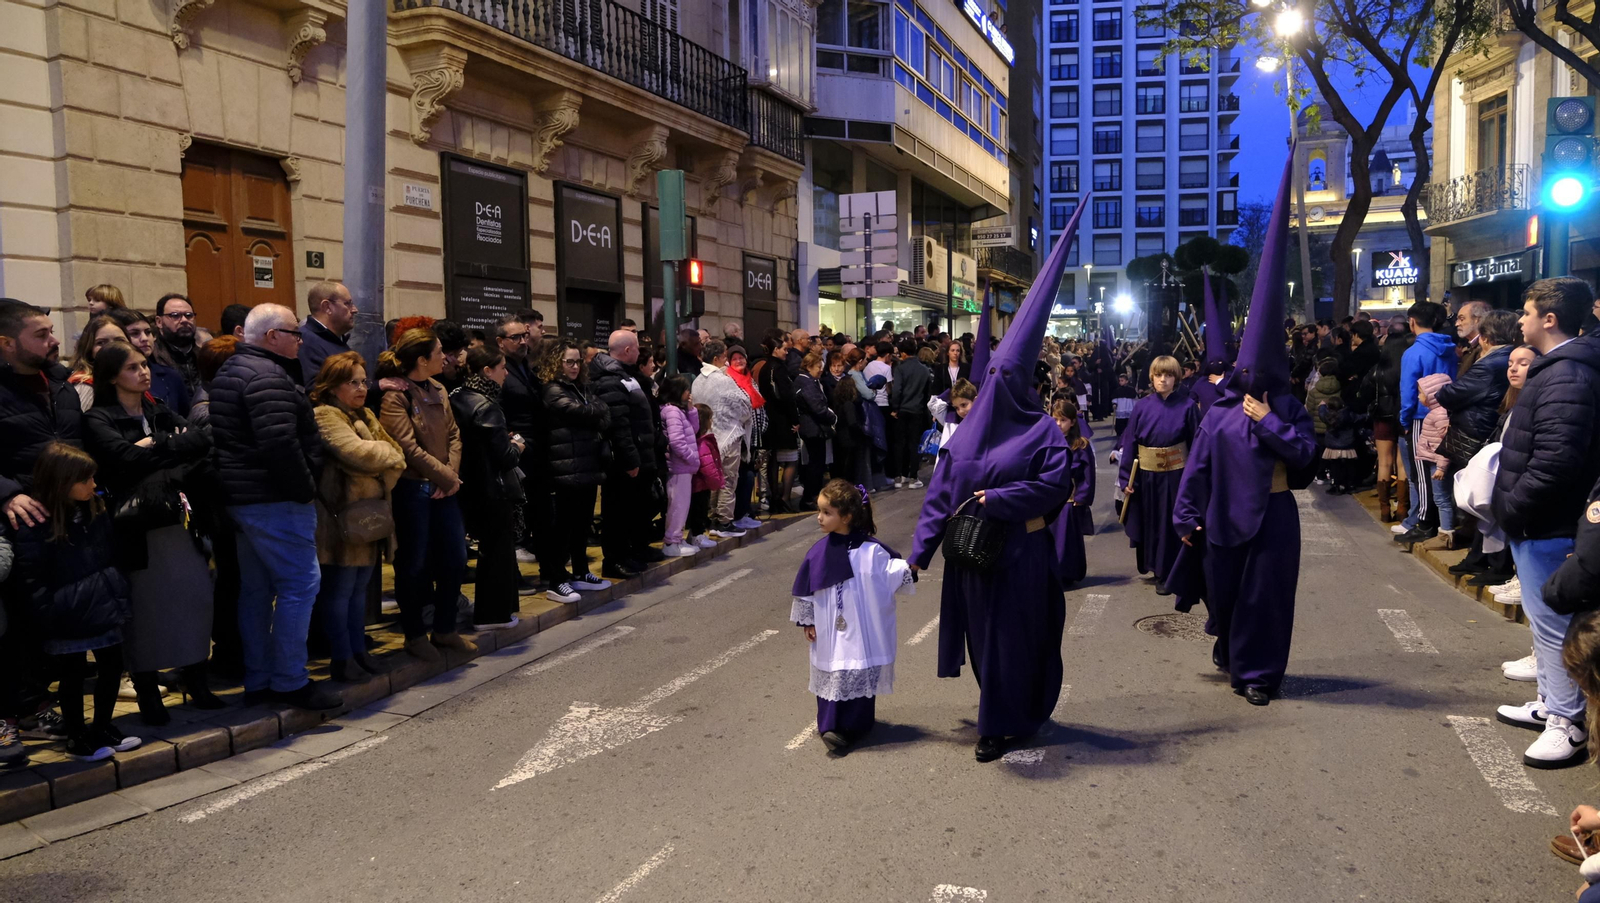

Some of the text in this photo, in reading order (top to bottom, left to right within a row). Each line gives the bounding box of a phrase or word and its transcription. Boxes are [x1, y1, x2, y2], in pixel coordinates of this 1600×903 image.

[405, 195, 431, 207] PURCHENA
[476, 216, 502, 228] Dentistas
[476, 233, 502, 244] Asociados
[311, 252, 320, 267] 6
